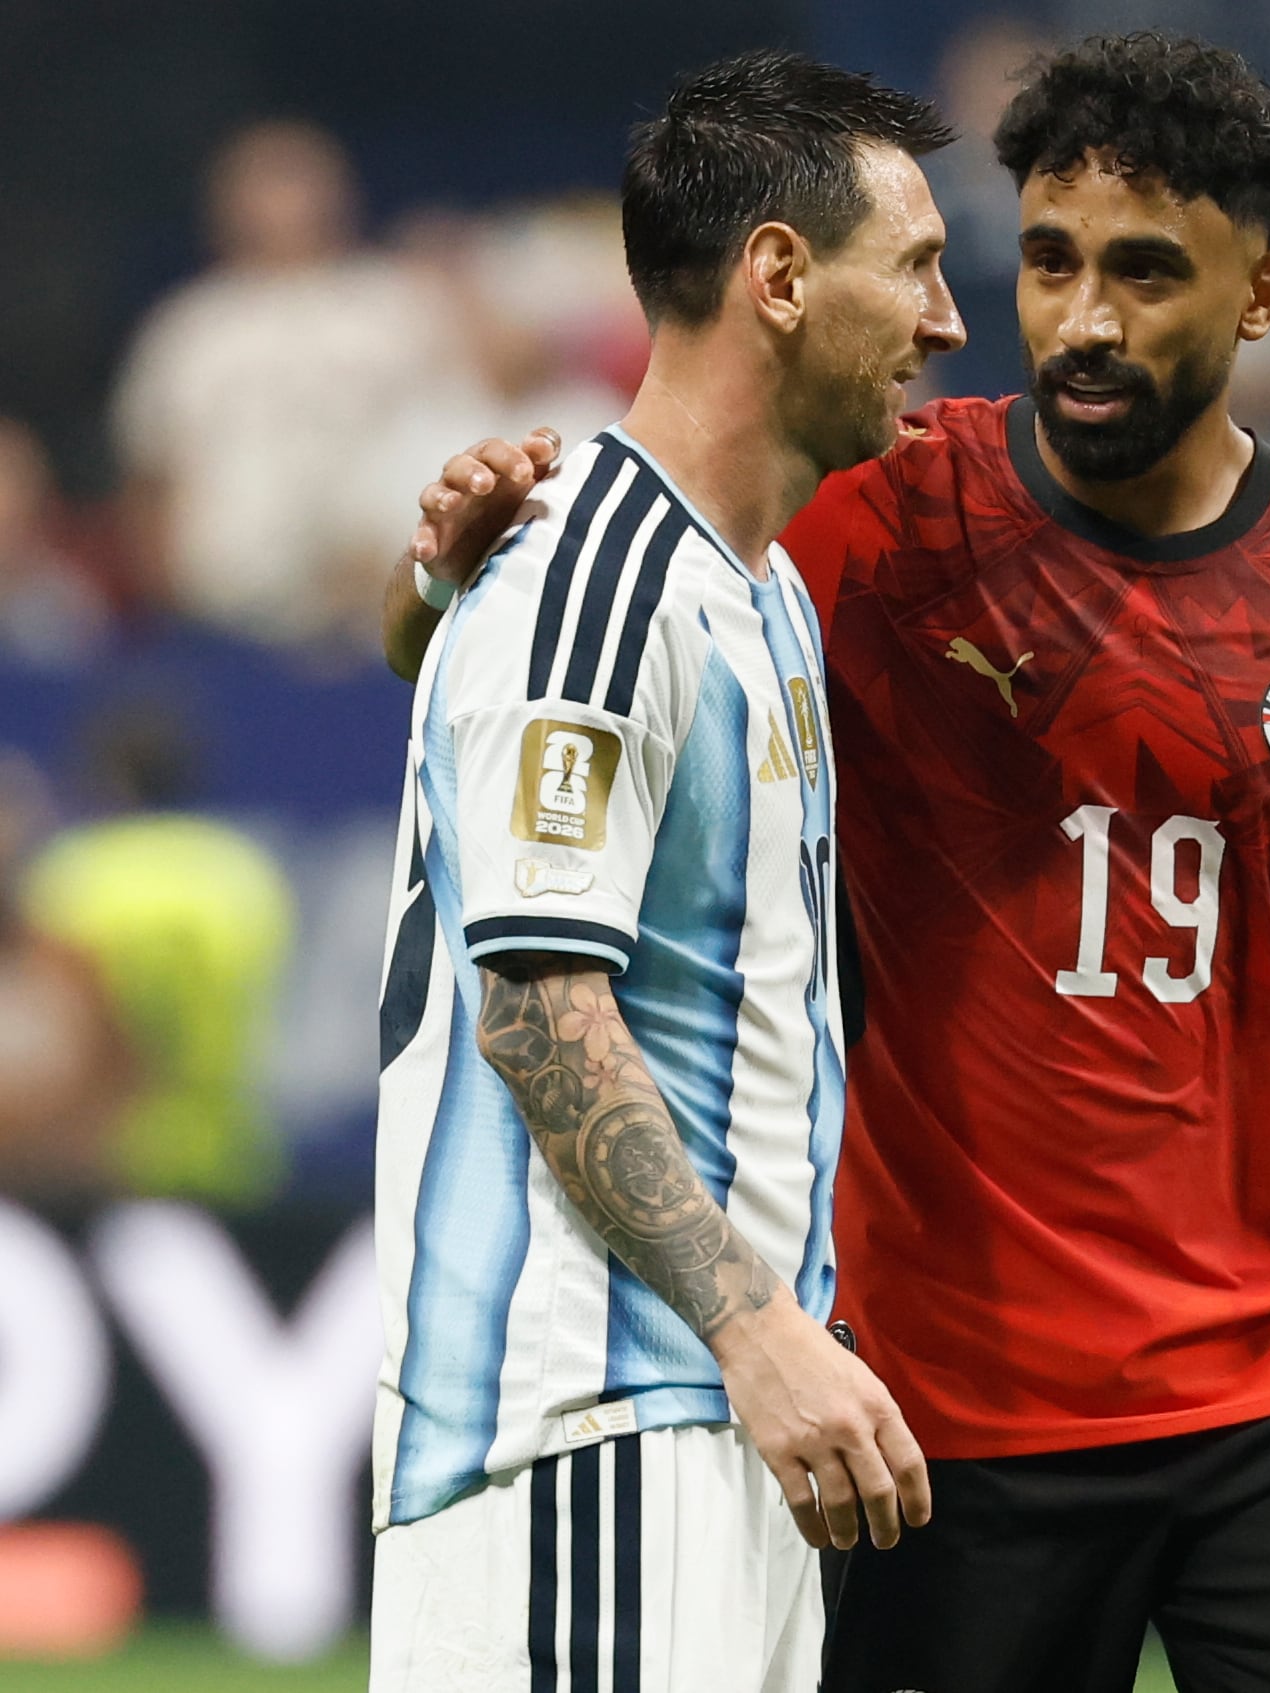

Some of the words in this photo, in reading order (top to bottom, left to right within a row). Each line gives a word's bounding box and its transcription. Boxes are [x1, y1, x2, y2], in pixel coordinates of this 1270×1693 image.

[554, 794, 575, 806] FIFA
[535, 820, 585, 839] 2026
[1055, 804, 1226, 1003] 19
